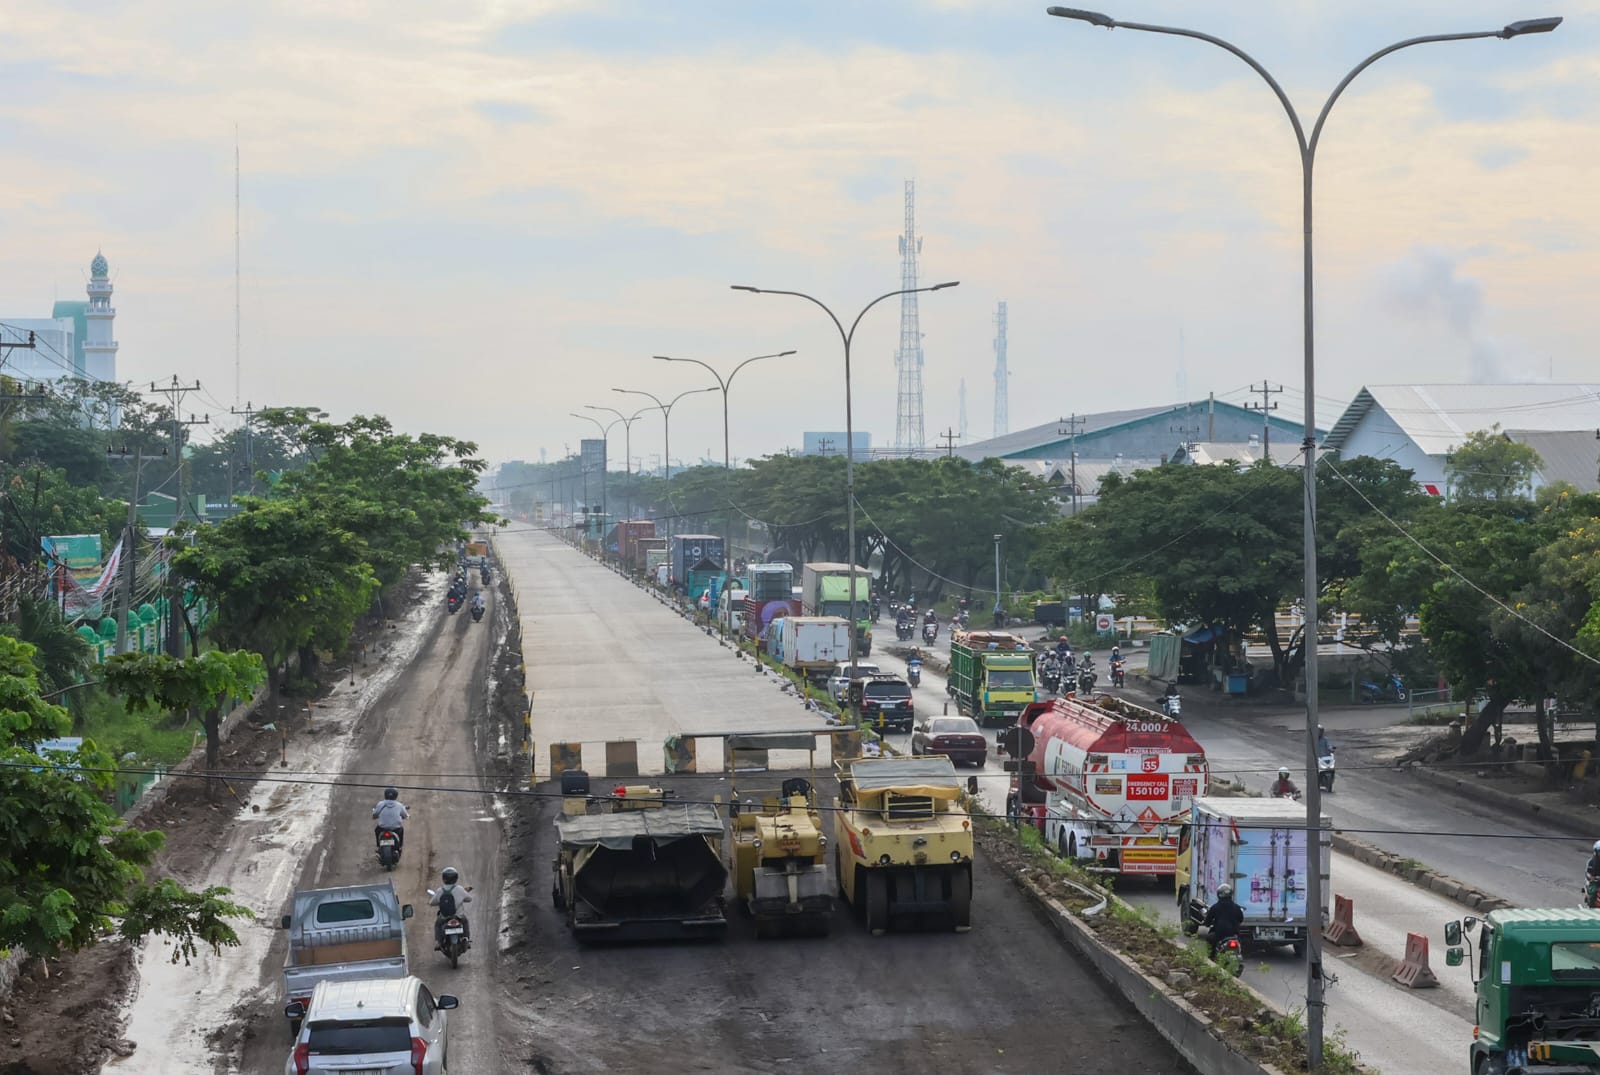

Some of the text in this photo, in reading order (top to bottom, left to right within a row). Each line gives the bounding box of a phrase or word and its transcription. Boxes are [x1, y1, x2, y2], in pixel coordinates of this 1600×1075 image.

[1126, 723, 1161, 732] 24.000
[1142, 761, 1157, 770] 135
[1130, 787, 1166, 795] 150109
